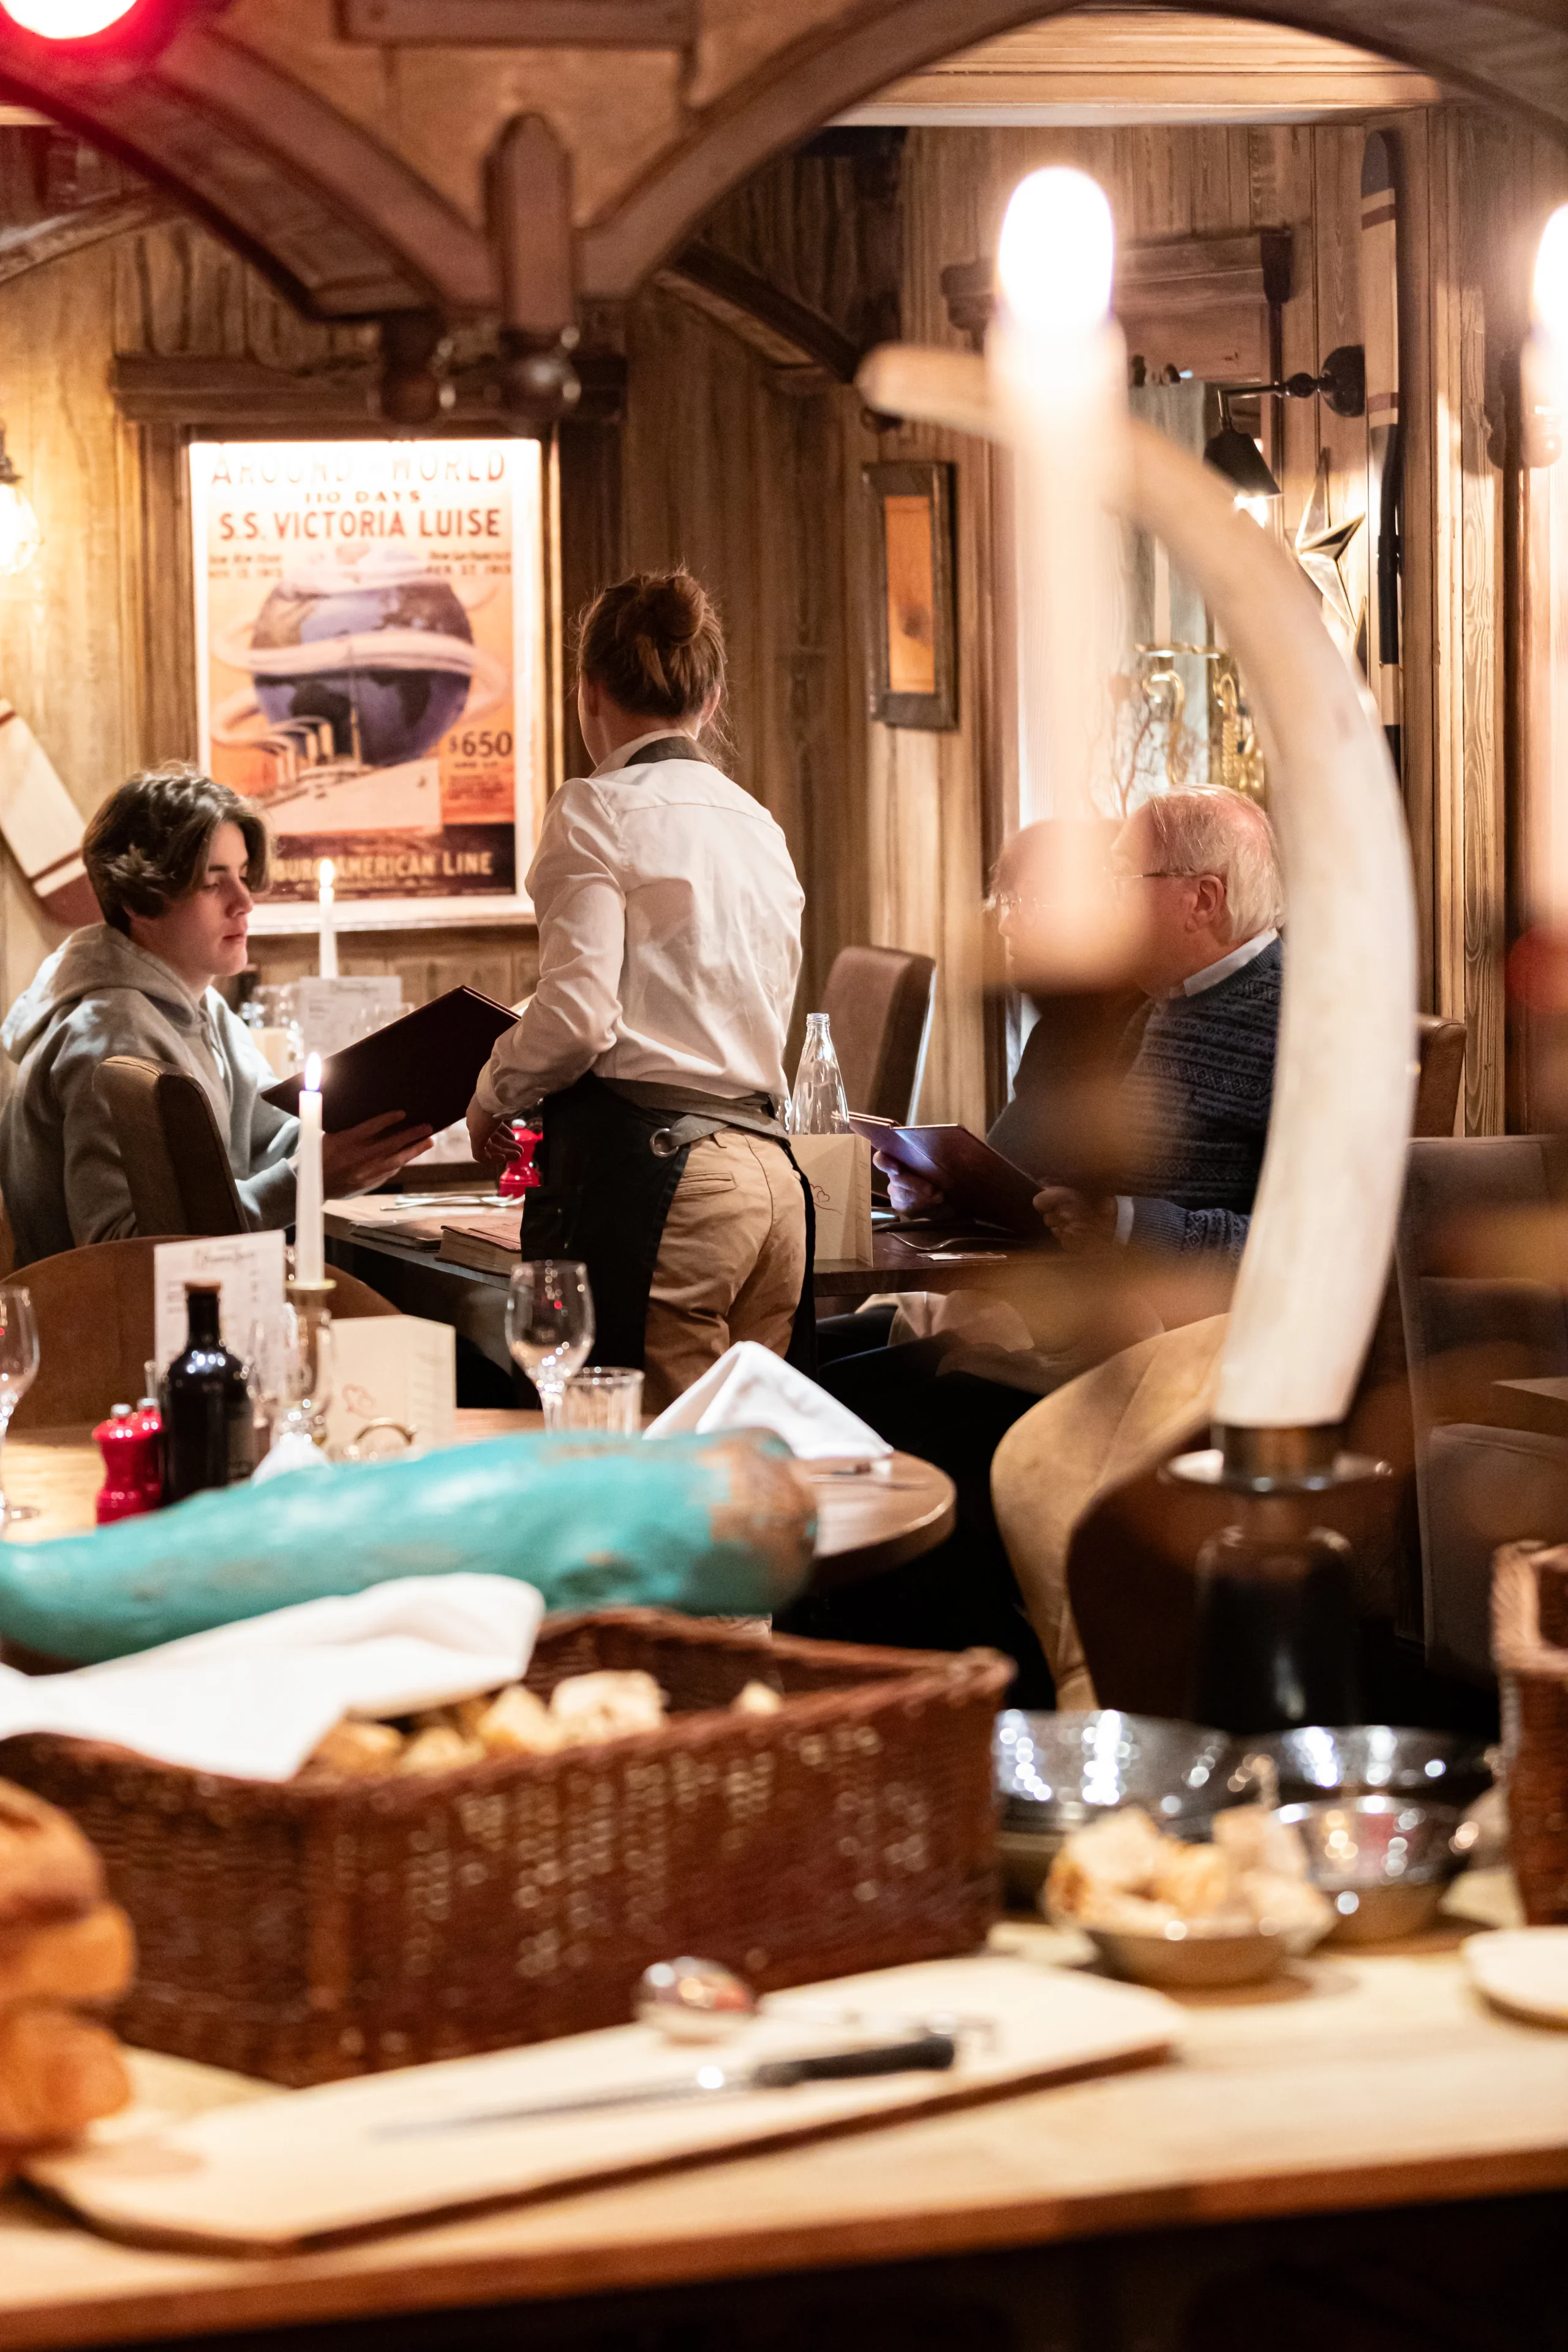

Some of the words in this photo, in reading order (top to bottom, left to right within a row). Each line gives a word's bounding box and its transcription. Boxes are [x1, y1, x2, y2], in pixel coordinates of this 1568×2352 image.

[211, 450, 352, 484] AROUND
[392, 449, 505, 482] WORLD
[305, 491, 341, 504] 110
[355, 490, 421, 504] DAYS
[219, 512, 267, 541] S.S.
[274, 510, 406, 539] VICTORIA
[420, 508, 500, 538] LUISE
[443, 850, 494, 876] LINE
